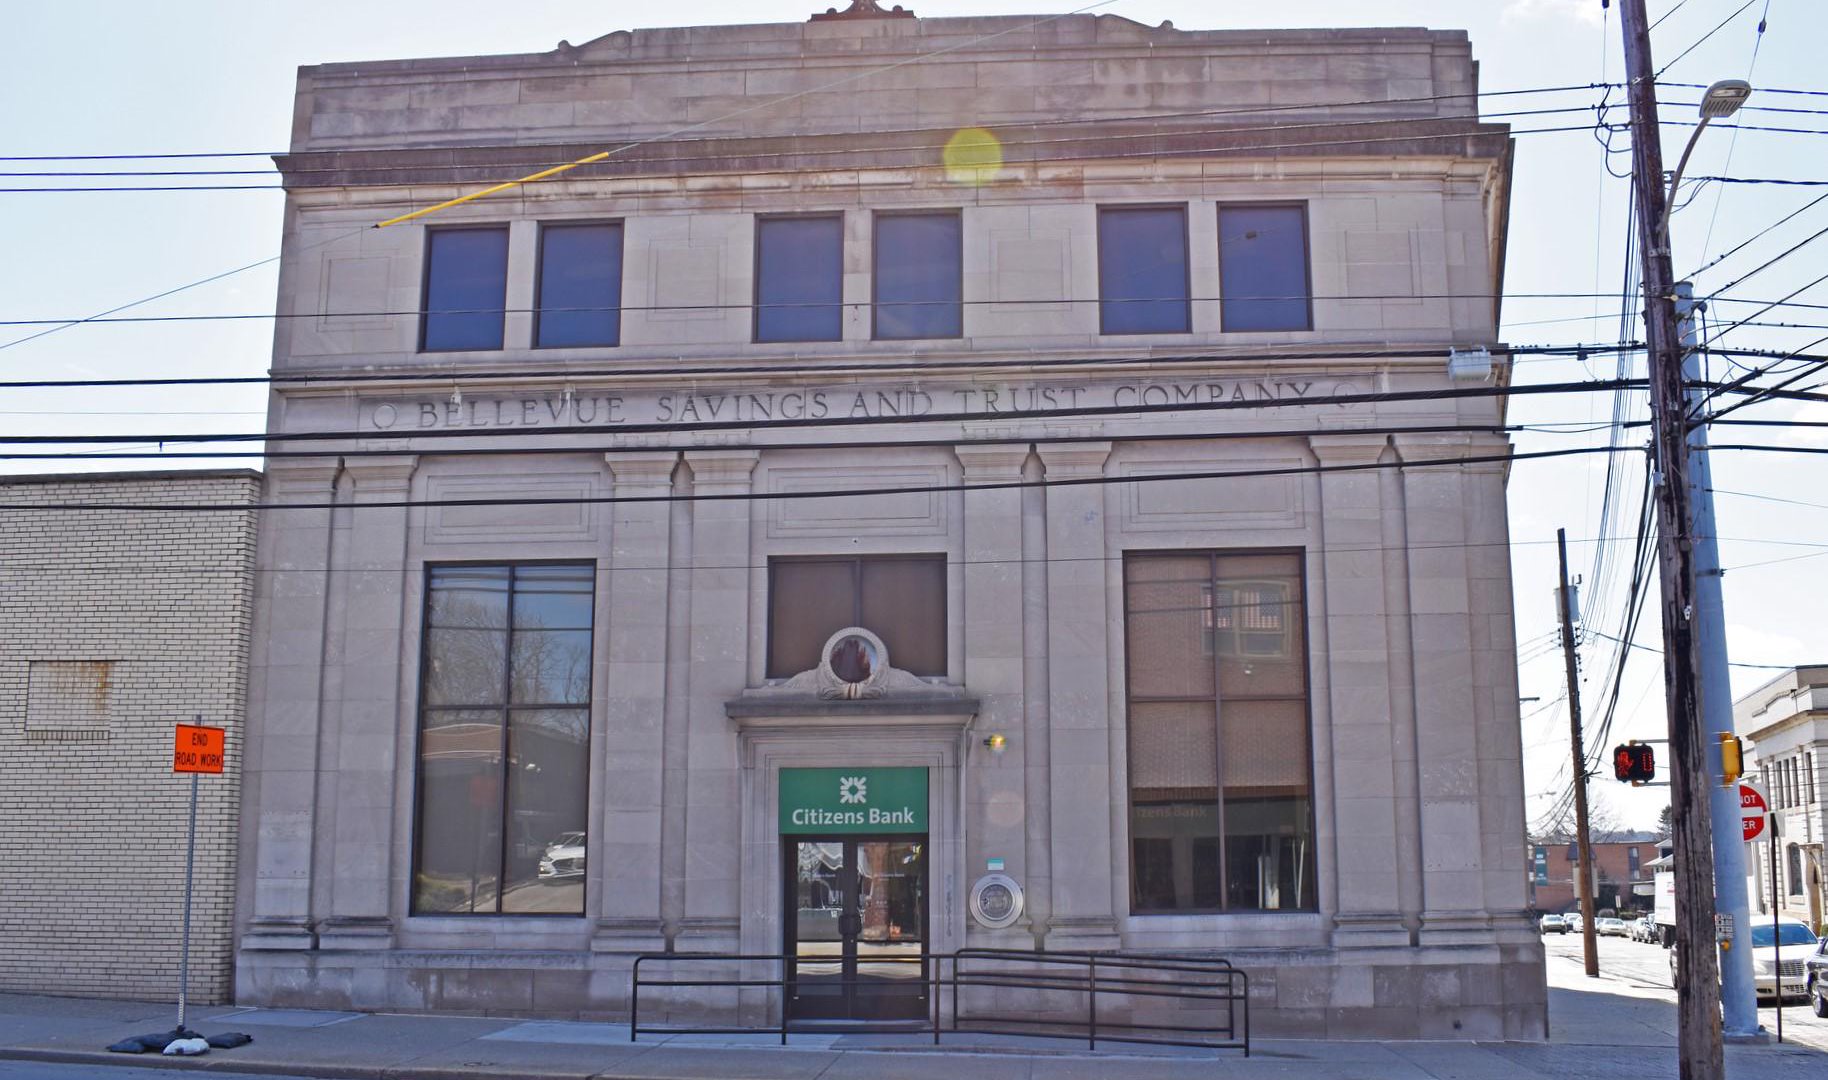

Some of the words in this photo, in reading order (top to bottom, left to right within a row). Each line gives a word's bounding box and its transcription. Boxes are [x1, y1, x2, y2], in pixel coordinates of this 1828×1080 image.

[416, 396, 626, 429] BELLEVUE
[656, 392, 829, 422] SAVINGS
[849, 389, 933, 419] AND
[953, 386, 1086, 413] TRUST
[1113, 382, 1313, 409] COMPANY
[192, 732, 208, 746] END
[175, 752, 196, 766] ROAD
[200, 753, 221, 767] WORK
[792, 808, 865, 825] Citizens
[869, 806, 914, 824] Bank
